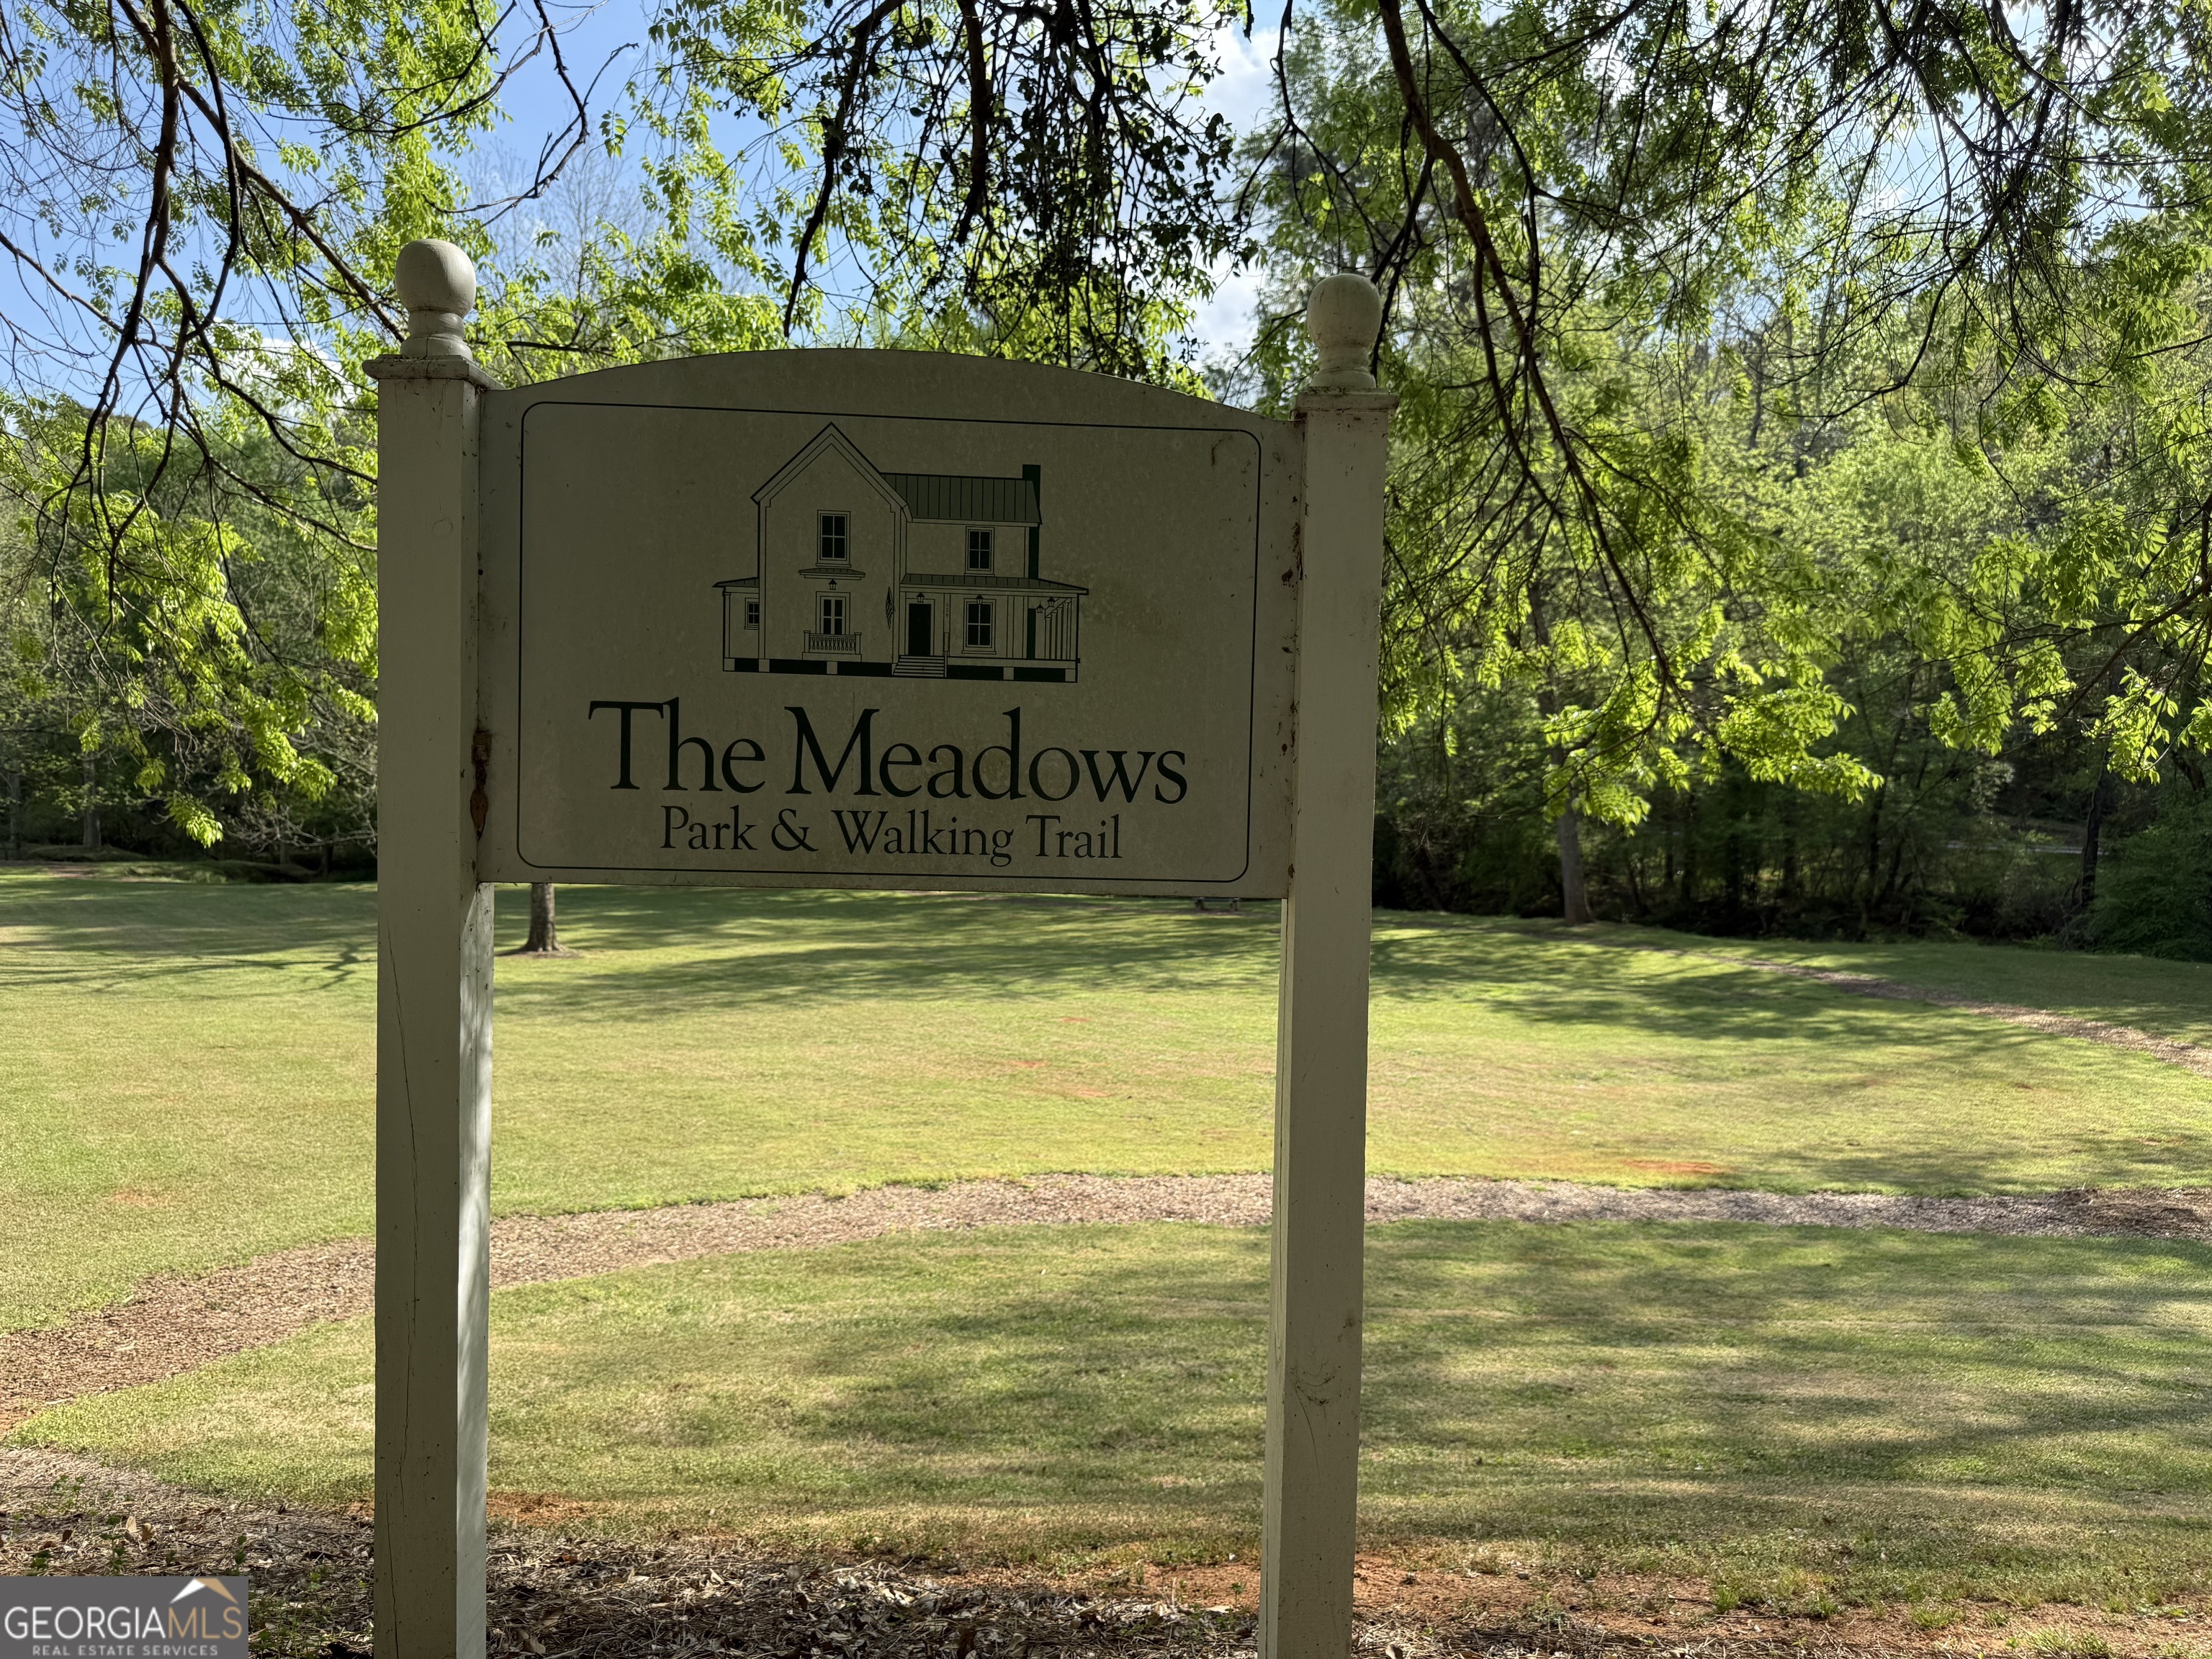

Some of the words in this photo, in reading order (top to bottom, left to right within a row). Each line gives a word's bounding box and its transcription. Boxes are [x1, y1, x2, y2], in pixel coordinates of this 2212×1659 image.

[588, 697, 765, 792] The
[784, 706, 1188, 804] Meadows
[660, 805, 758, 851] Park
[770, 808, 819, 852] &
[831, 809, 1014, 867] Walking
[1026, 814, 1123, 859] Trail
